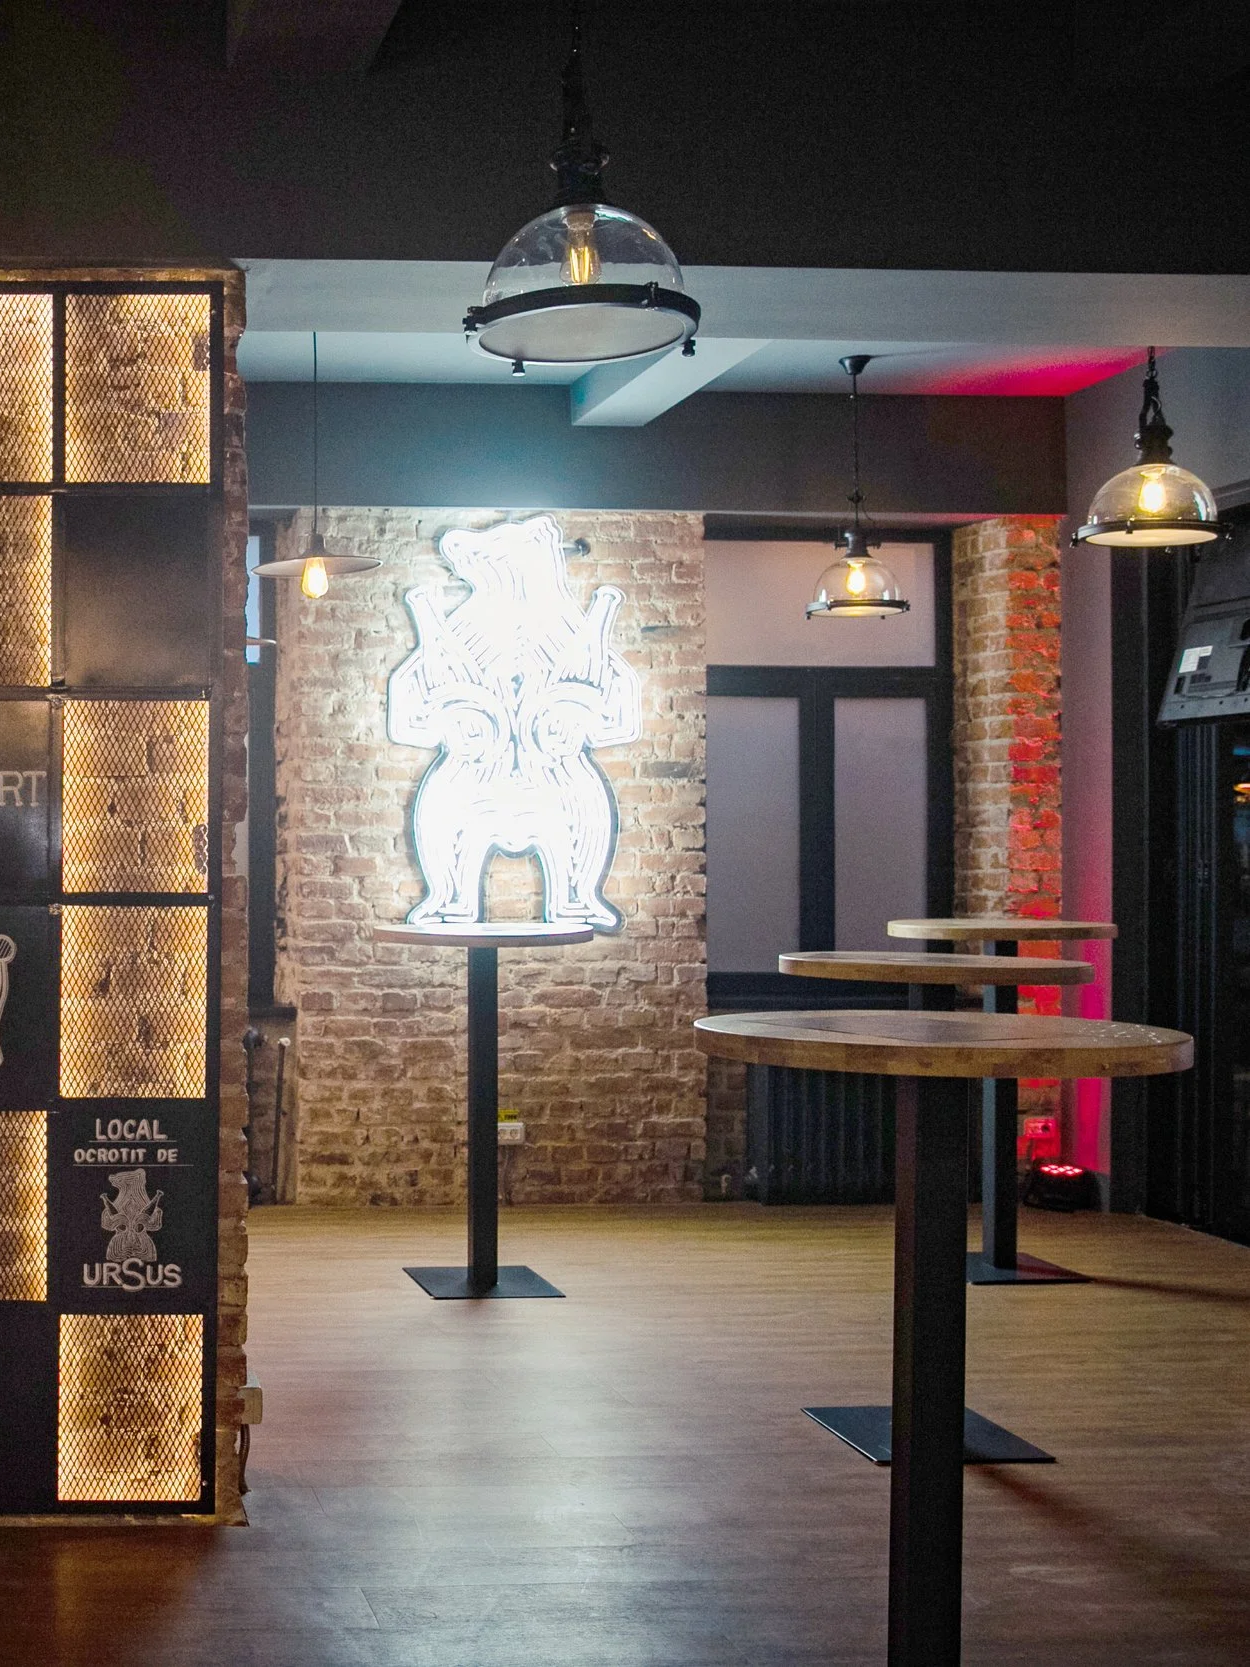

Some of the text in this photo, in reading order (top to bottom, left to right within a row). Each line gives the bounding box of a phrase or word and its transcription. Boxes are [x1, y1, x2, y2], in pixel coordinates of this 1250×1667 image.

[95, 1118, 168, 1141] LOCAL
[74, 1148, 178, 1163] OCROTIT DE
[83, 1257, 183, 1292] URSUS
